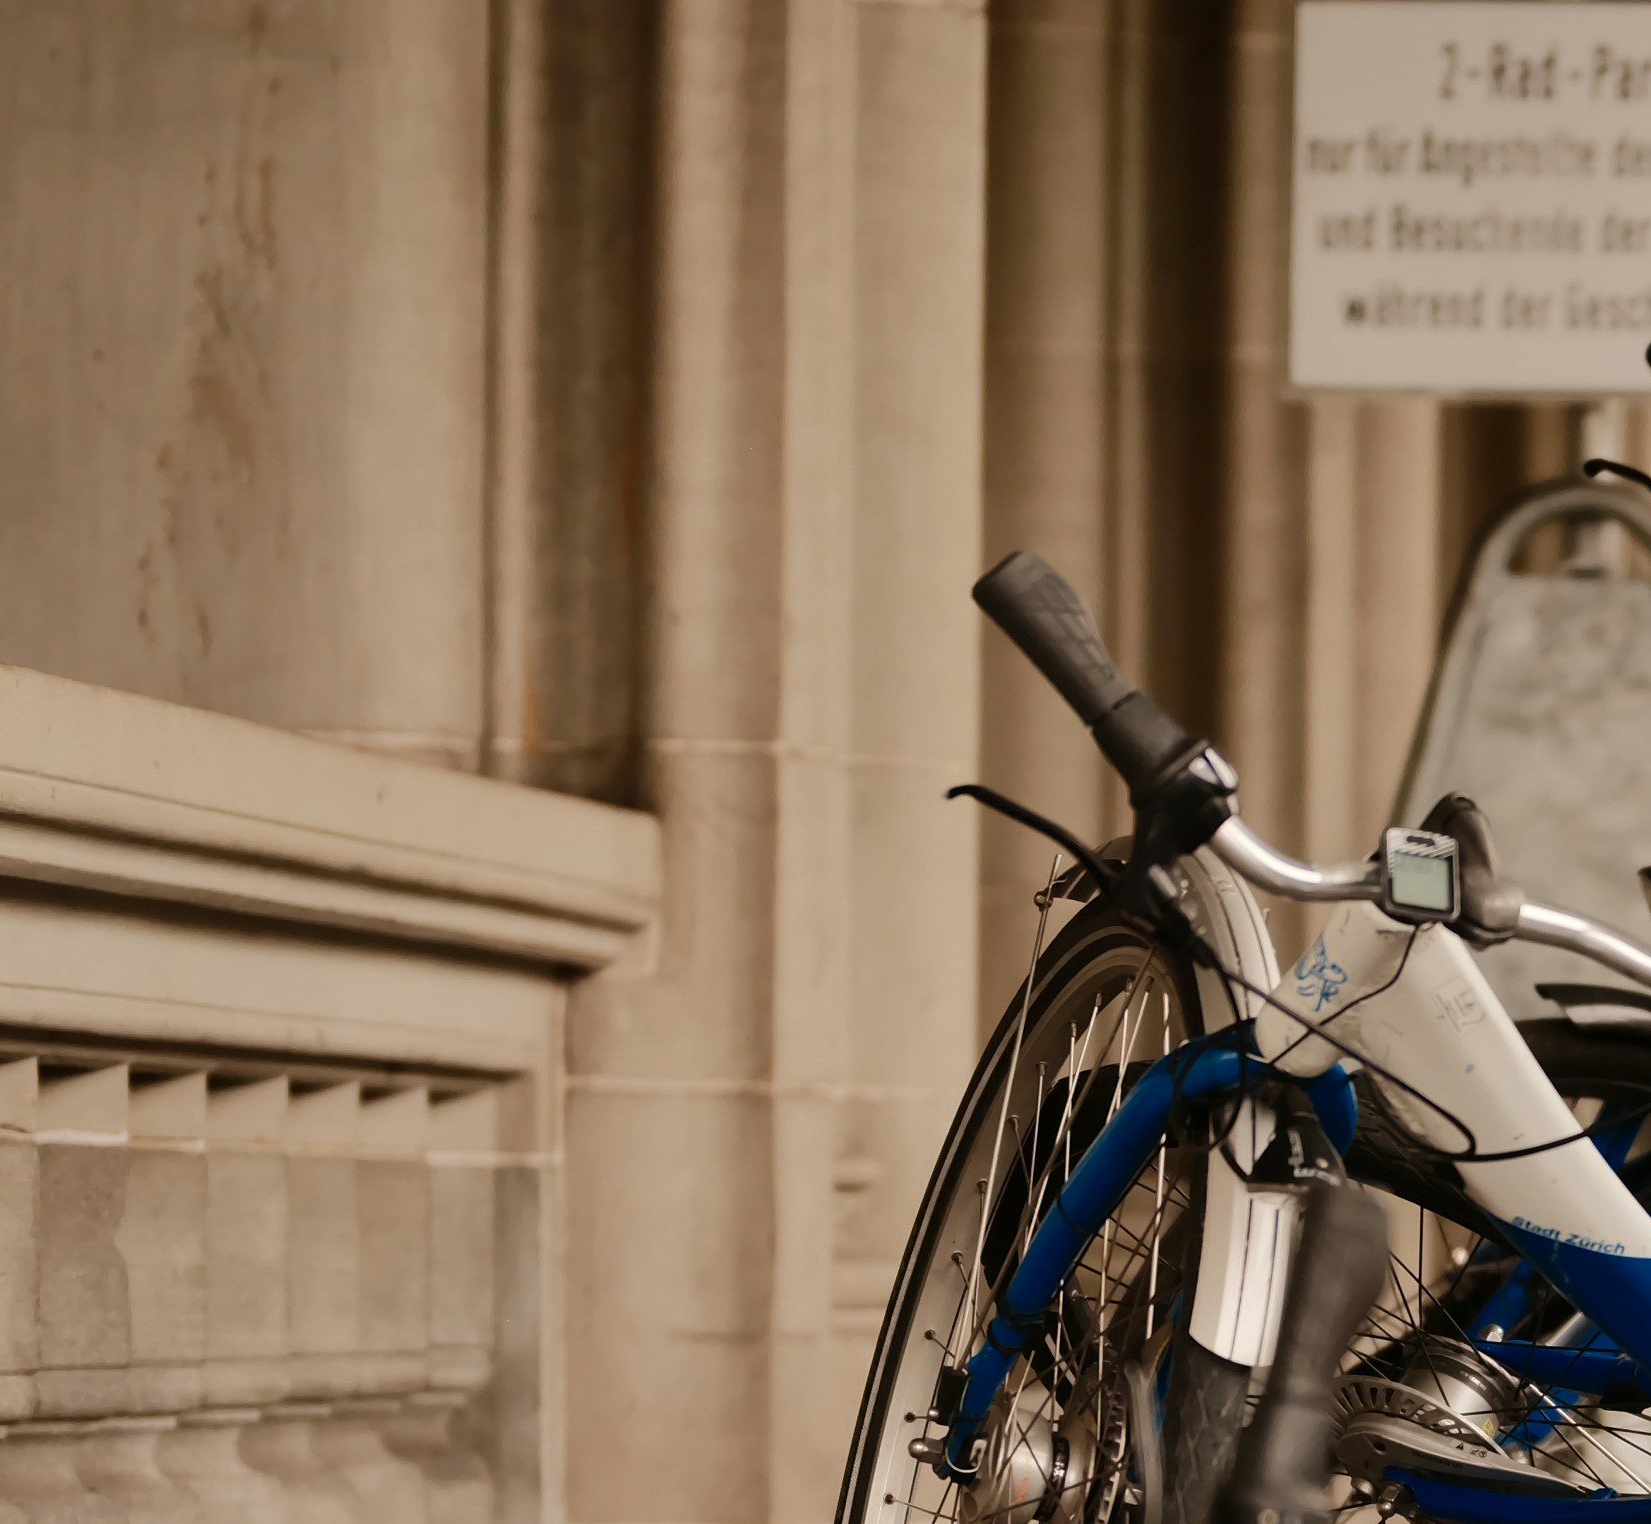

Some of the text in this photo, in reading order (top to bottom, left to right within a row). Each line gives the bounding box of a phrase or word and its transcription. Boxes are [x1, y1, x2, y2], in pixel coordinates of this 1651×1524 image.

[1306, 136, 1355, 178] nur
[1363, 129, 1411, 177] für
[1419, 130, 1596, 186] Angestellte
[1317, 206, 1376, 254] und
[1389, 204, 1583, 255] Besuchende
[1598, 208, 1651, 255] der
[1343, 288, 1484, 330] während
[1500, 287, 1551, 330] der
[1511, 1216, 1626, 1255] Stadt Zürich
